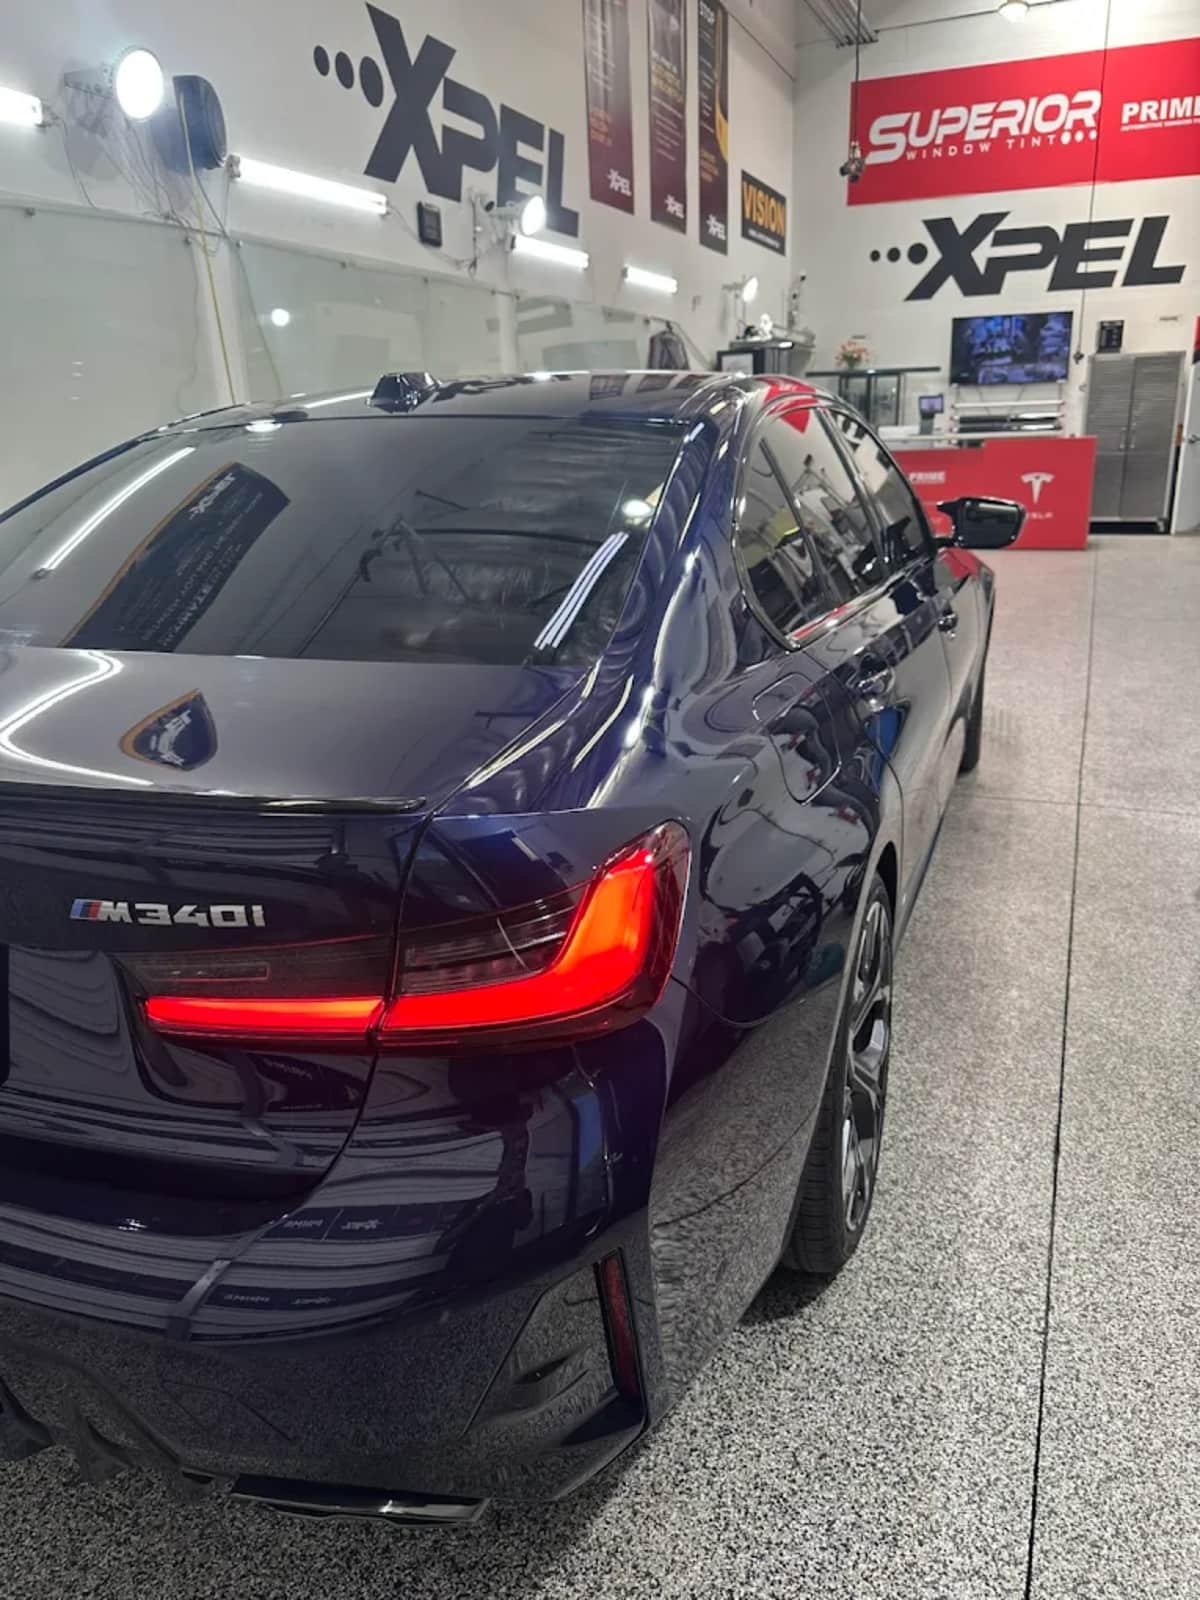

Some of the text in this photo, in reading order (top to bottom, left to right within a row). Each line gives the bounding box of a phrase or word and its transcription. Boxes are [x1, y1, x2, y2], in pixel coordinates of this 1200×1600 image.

[364, 2, 580, 238] XPEL
[866, 90, 1102, 164] SUPERIOR
[905, 134, 1055, 161] WINDOW TINT
[608, 168, 632, 197] XPEL
[665, 194, 685, 219] XPEL
[706, 214, 727, 240] XPEL
[743, 181, 785, 237] VISION
[903, 210, 1187, 302] XPEL
